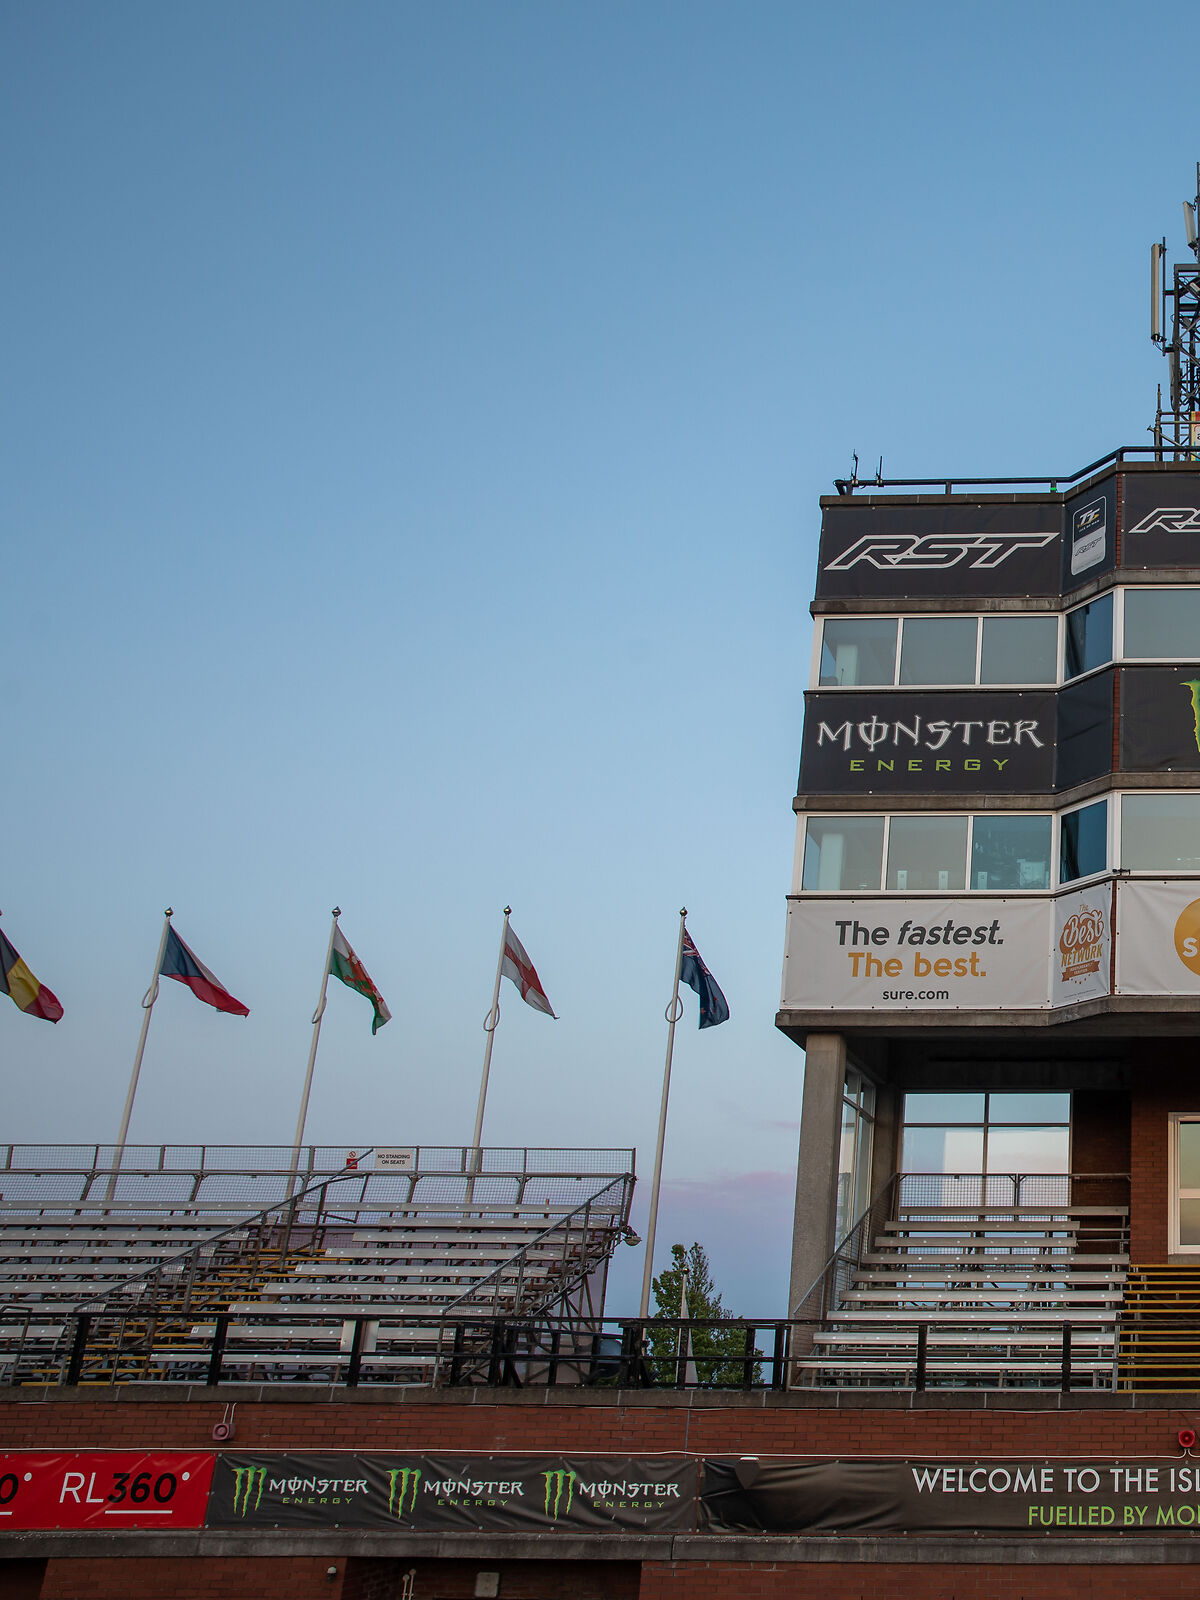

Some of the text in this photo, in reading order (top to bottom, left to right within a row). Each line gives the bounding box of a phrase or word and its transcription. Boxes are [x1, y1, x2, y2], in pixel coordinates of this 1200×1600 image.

[823, 532, 1060, 571] RST
[816, 714, 1045, 752] MONSTER
[849, 758, 1010, 772] ENERGY
[835, 919, 1004, 946] The fastest.
[1061, 910, 1104, 948] Best
[848, 951, 987, 978] The best.
[1061, 943, 1104, 967] NETWORK
[883, 987, 950, 1001] sure.com
[269, 1475, 369, 1495] MONSTER
[423, 1477, 525, 1497] MONSTER
[578, 1479, 681, 1498] MONSTER
[912, 1467, 1054, 1493] WELCOME
[1064, 1468, 1101, 1493] TO
[1110, 1468, 1159, 1493] THE
[1028, 1505, 1116, 1526] FUELLED
[1123, 1505, 1149, 1525] BY
